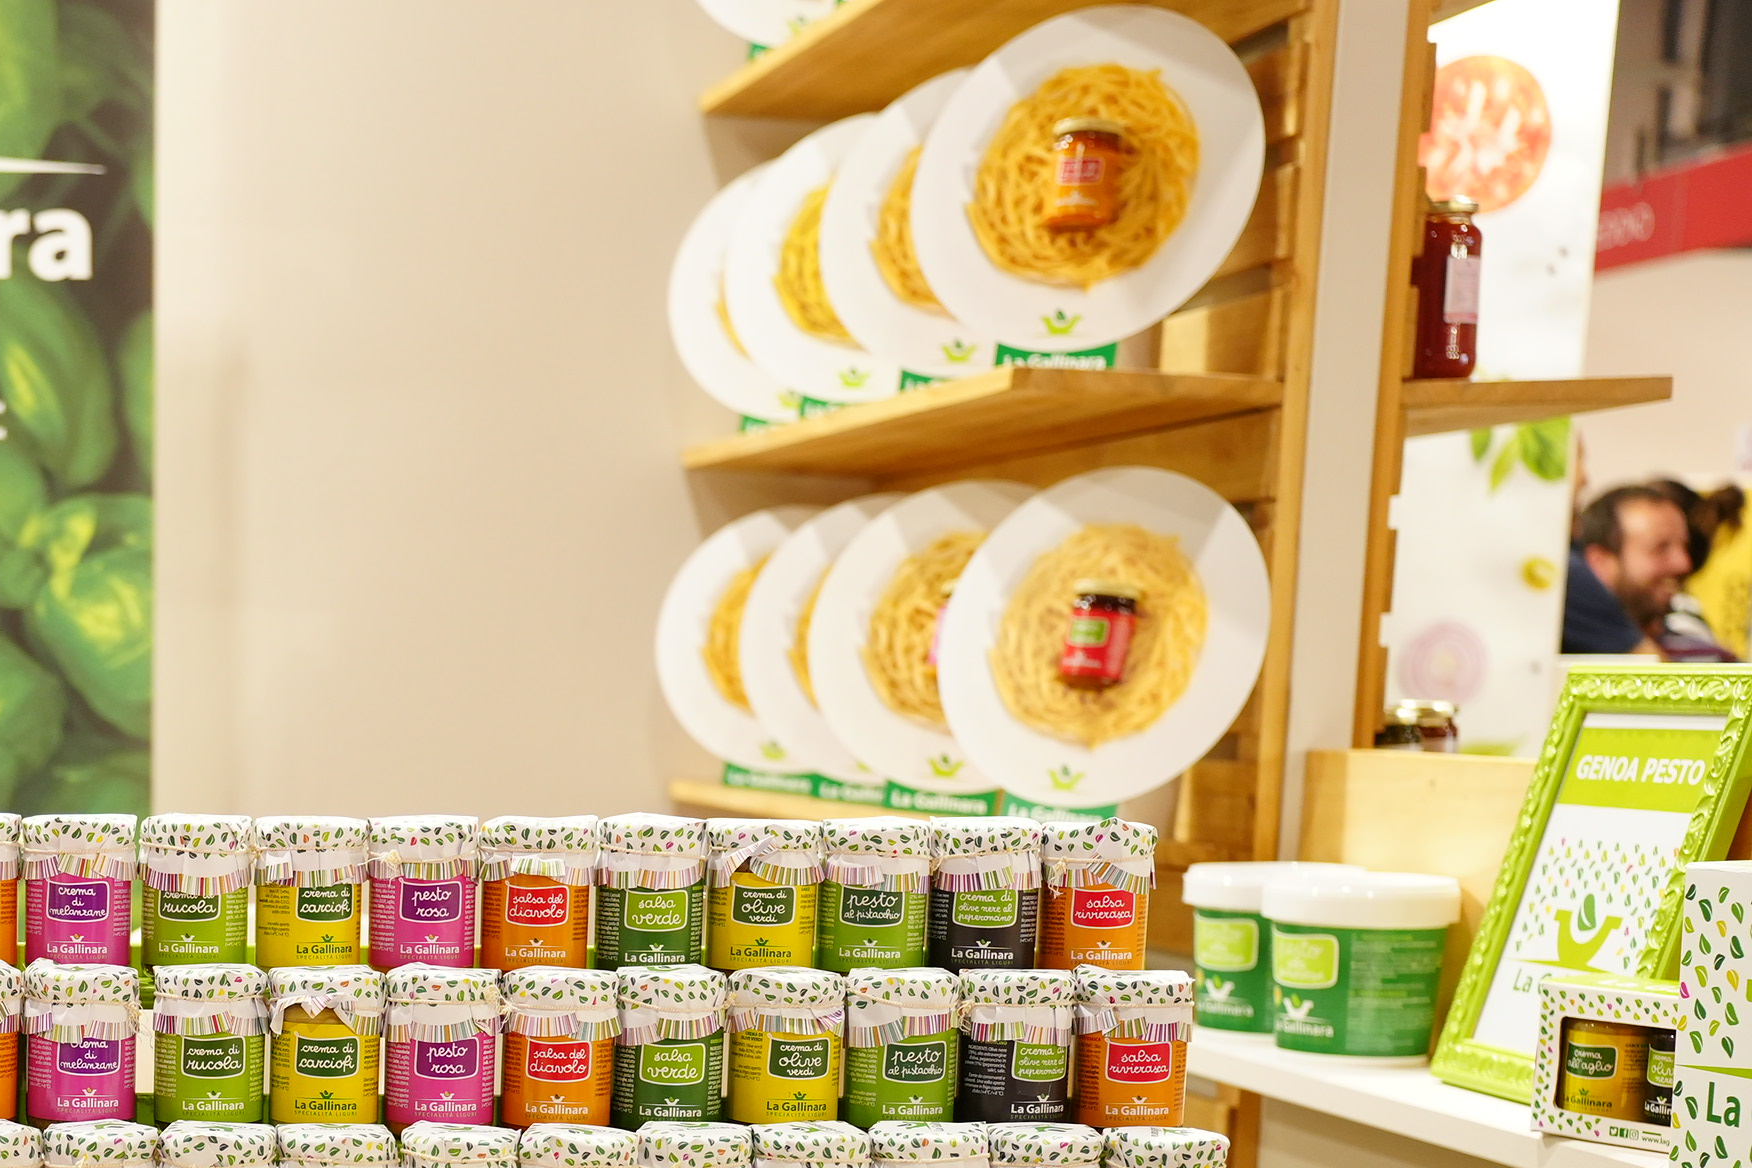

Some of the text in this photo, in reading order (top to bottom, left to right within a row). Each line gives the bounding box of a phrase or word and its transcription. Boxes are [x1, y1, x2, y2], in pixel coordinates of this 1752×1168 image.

[1576, 755, 1706, 784] GENOA PESTO
[301, 887, 350, 898] crema di
[743, 888, 787, 900] crema di
[301, 899, 350, 915] carciofi
[742, 899, 785, 914] olive
[750, 912, 777, 923] verdi
[296, 944, 352, 955] La Gallinara
[730, 947, 791, 959] La Gallinara
[187, 1045, 240, 1056] crema di
[427, 1045, 466, 1060] pesto
[655, 1049, 693, 1062] salsa
[892, 1048, 941, 1064] pesto
[186, 1057, 241, 1071] rucola
[431, 1061, 465, 1074] rosa
[888, 1065, 899, 1075] al
[646, 1063, 699, 1079] verde
[182, 1100, 244, 1111] La Gallinara
[415, 1102, 476, 1112] La Gallinara
[882, 1105, 943, 1116] La Gallinara
[1707, 1082, 1741, 1128] La
[639, 1107, 701, 1117] La Gallinara
